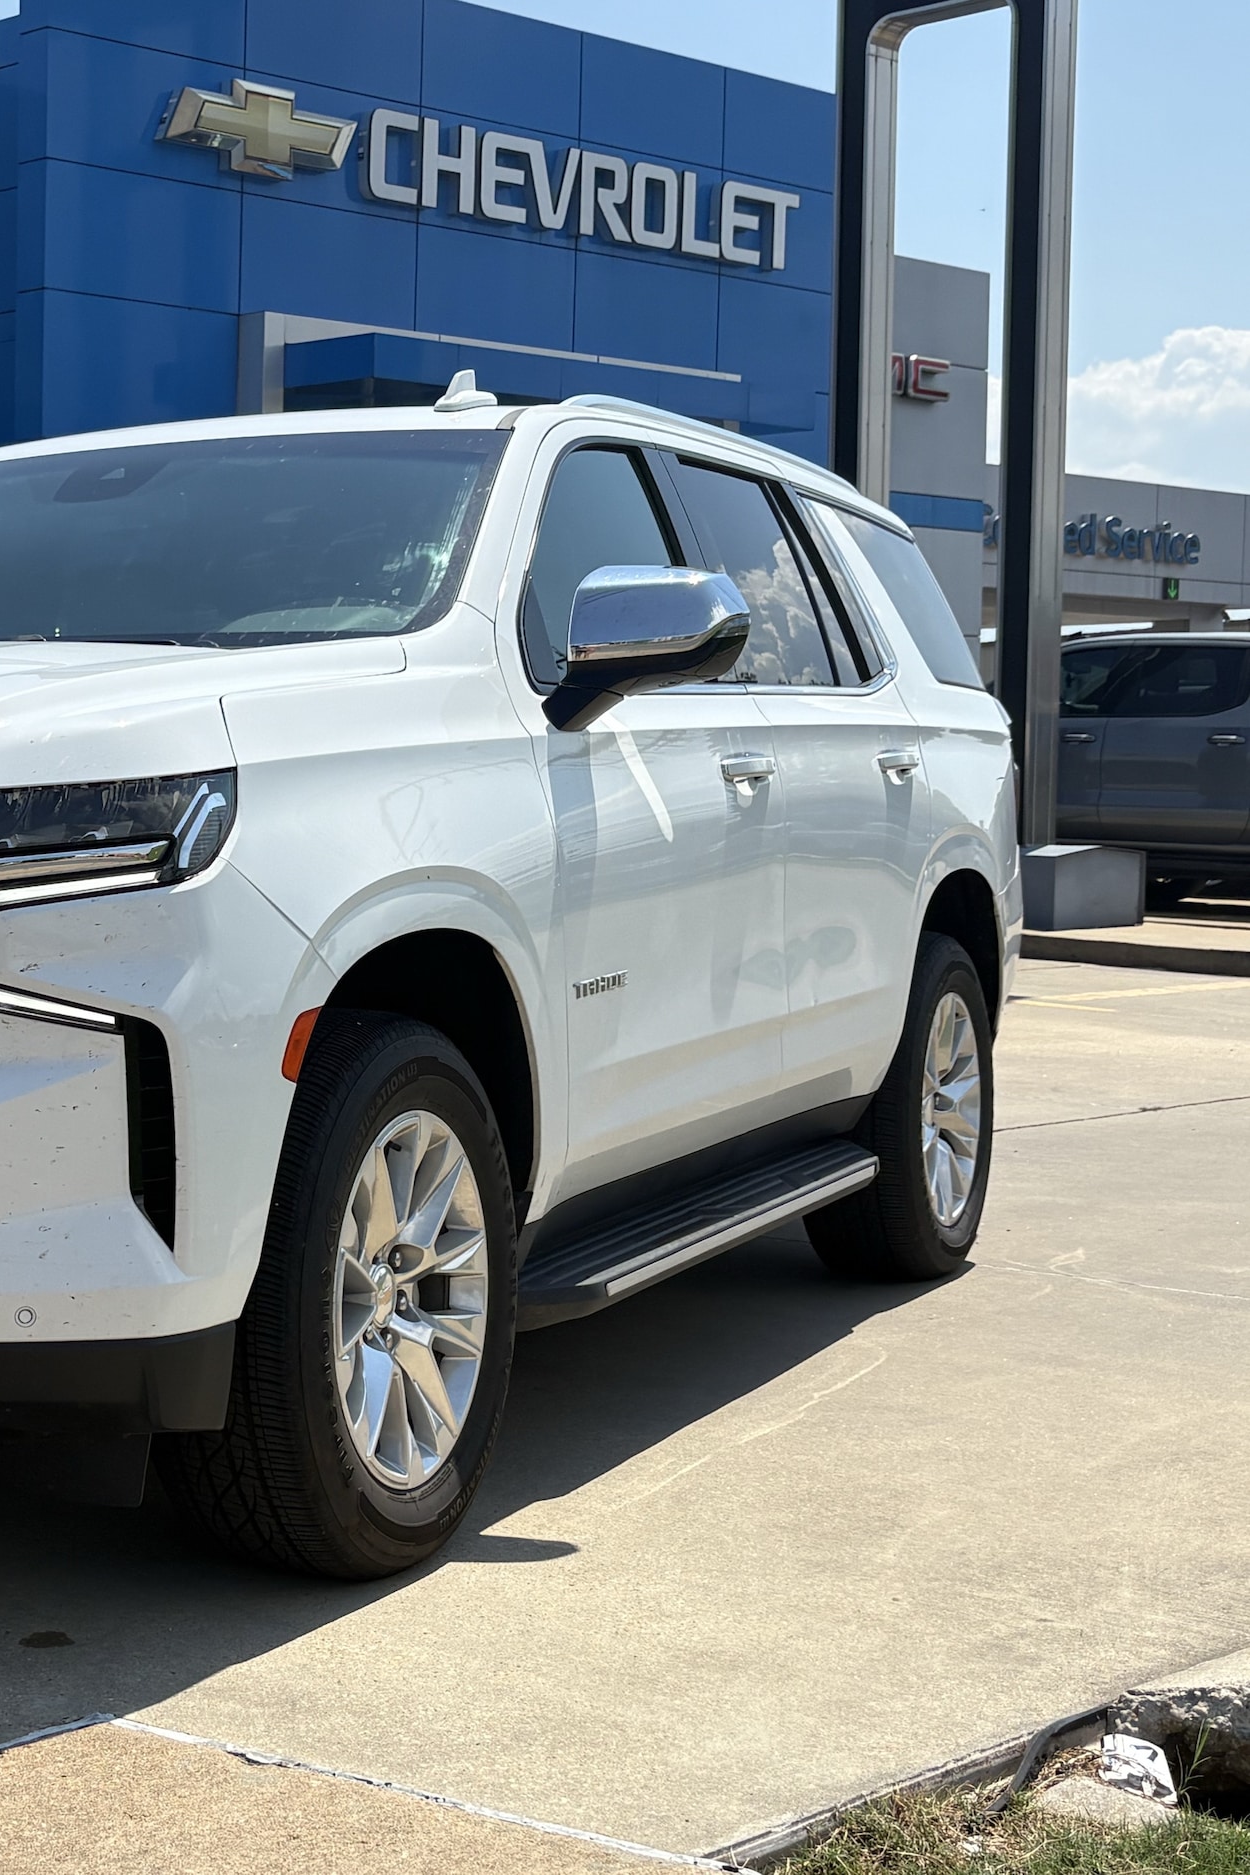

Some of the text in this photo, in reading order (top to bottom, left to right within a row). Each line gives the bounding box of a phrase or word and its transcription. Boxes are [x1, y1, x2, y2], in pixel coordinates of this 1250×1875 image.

[366, 107, 800, 271] CHEVROLET
[1105, 514, 1200, 565] Service
[572, 969, 629, 1000] TAHOE
